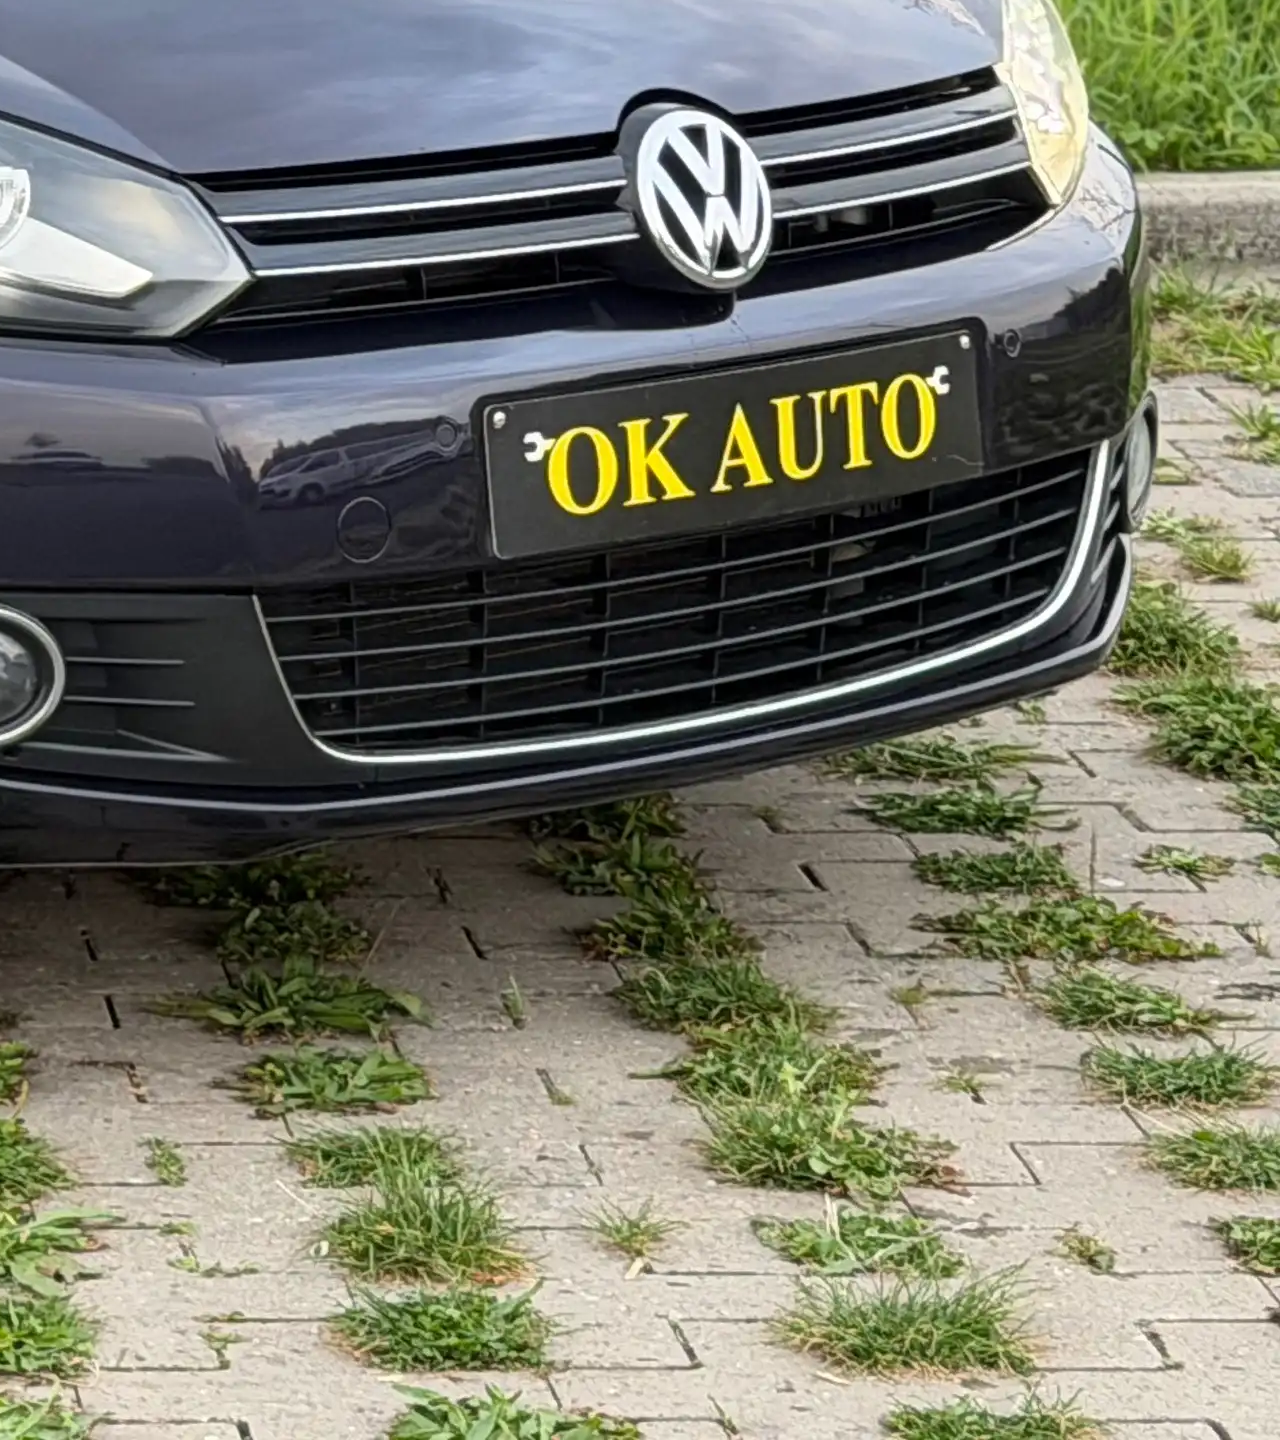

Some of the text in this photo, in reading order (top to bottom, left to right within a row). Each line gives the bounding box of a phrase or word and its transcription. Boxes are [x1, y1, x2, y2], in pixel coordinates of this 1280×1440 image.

[639, 111, 771, 280] VW
[547, 373, 936, 516] OK AUTO
